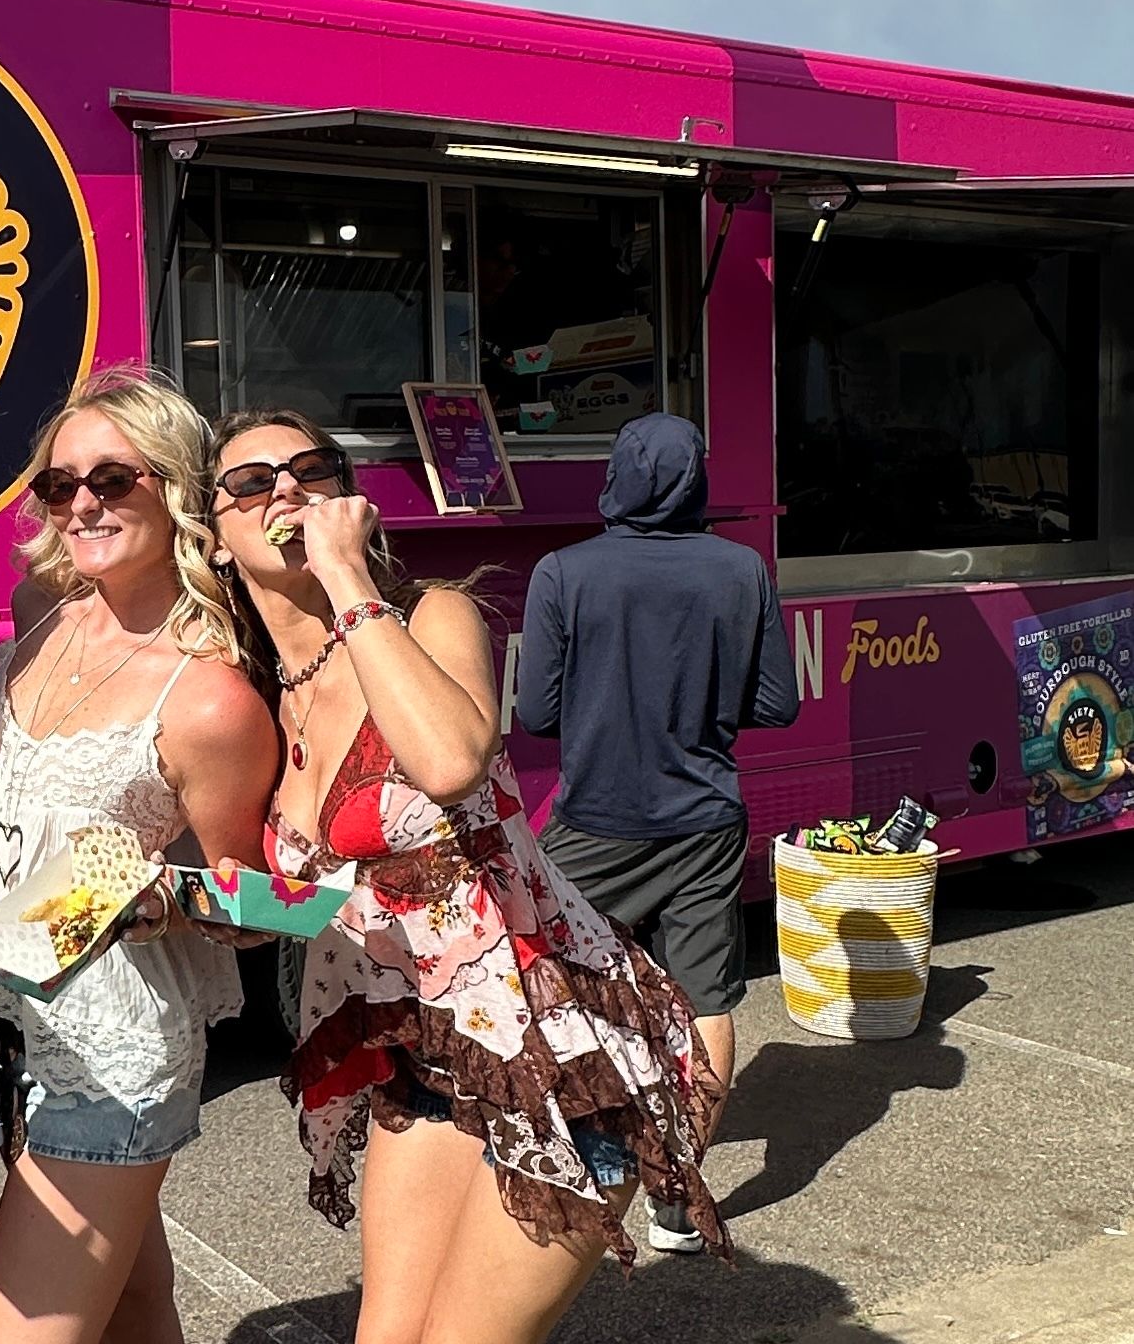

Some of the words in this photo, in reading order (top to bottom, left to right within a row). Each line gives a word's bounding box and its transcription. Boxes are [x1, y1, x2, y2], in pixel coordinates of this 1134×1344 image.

[577, 393, 629, 408] EGGS
[1018, 628, 1056, 647] GLUTEN
[1058, 621, 1082, 636] FREE
[1082, 607, 1132, 628] TORTILLAS
[840, 615, 941, 685] Foods
[1032, 655, 1096, 726] SOURDOUGH
[1097, 659, 1128, 702] STYLE
[1068, 706, 1095, 724] SIETE
